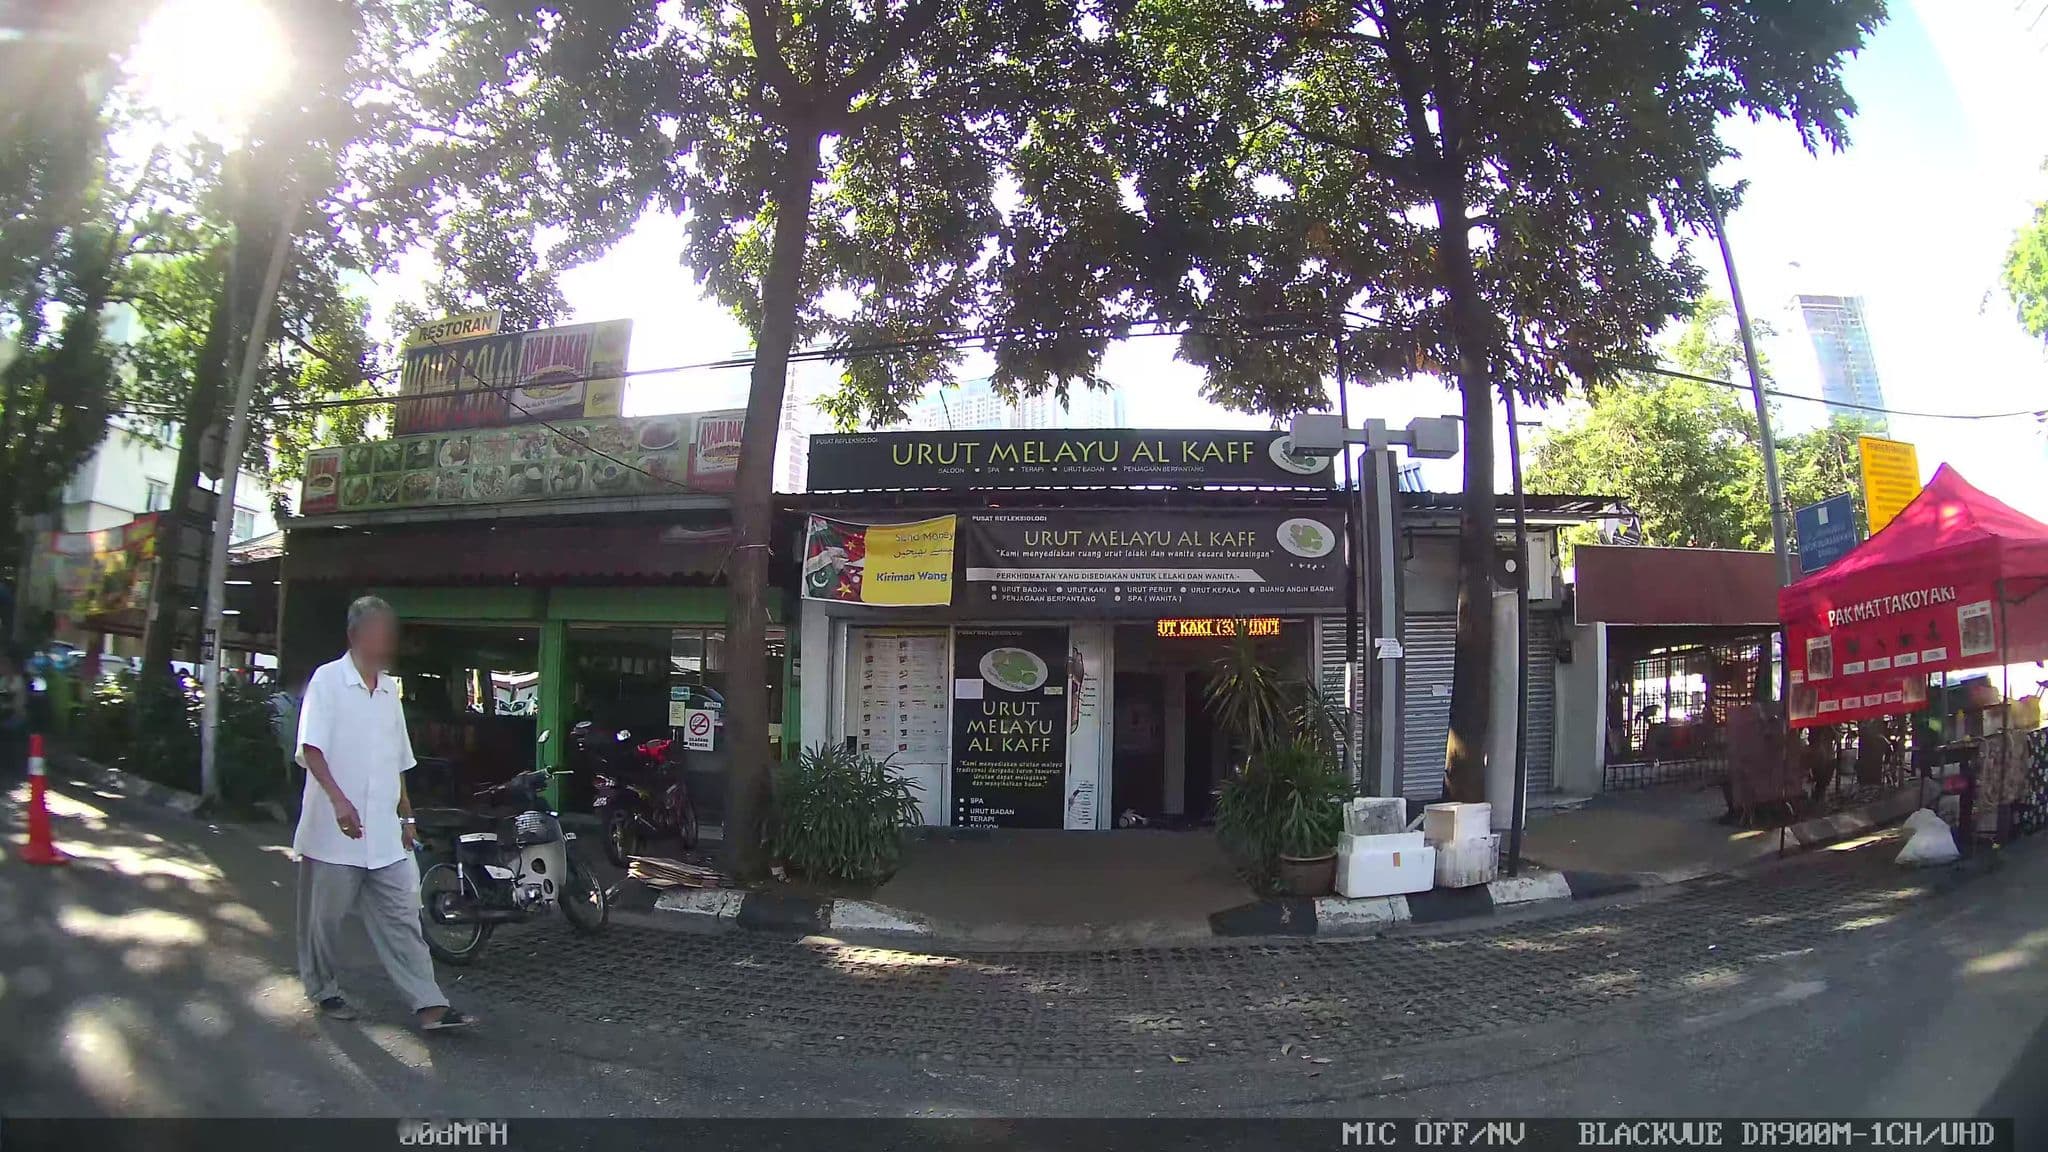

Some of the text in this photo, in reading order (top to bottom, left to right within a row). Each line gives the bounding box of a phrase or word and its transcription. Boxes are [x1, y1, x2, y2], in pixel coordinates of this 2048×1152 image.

[418, 316, 493, 342] RESTORAN
[893, 440, 1254, 465] URUT MELAYU AL KAFF
[1025, 530, 1256, 547] URUT MELAYU AL KAFF
[1022, 549, 1075, 558] menyediakan
[1078, 550, 1102, 559] ruang
[1125, 549, 1148, 557] lelaki
[876, 571, 947, 583] Kiriman Wang
[996, 572, 1056, 580] PERKHIDMATAN
[1058, 572, 1079, 580] YANG
[1081, 572, 1128, 580] DISEDIAKAN
[1130, 572, 1157, 580] UNTUK
[1158, 572, 1185, 580] LELAKI
[1187, 572, 1203, 580] DAN
[1180, 621, 1212, 635] KAKI
[982, 701, 1040, 716] URUT
[966, 720, 1053, 735] MELAYU
[968, 737, 1050, 752] AL KAFF
[970, 797, 984, 805] SPA
